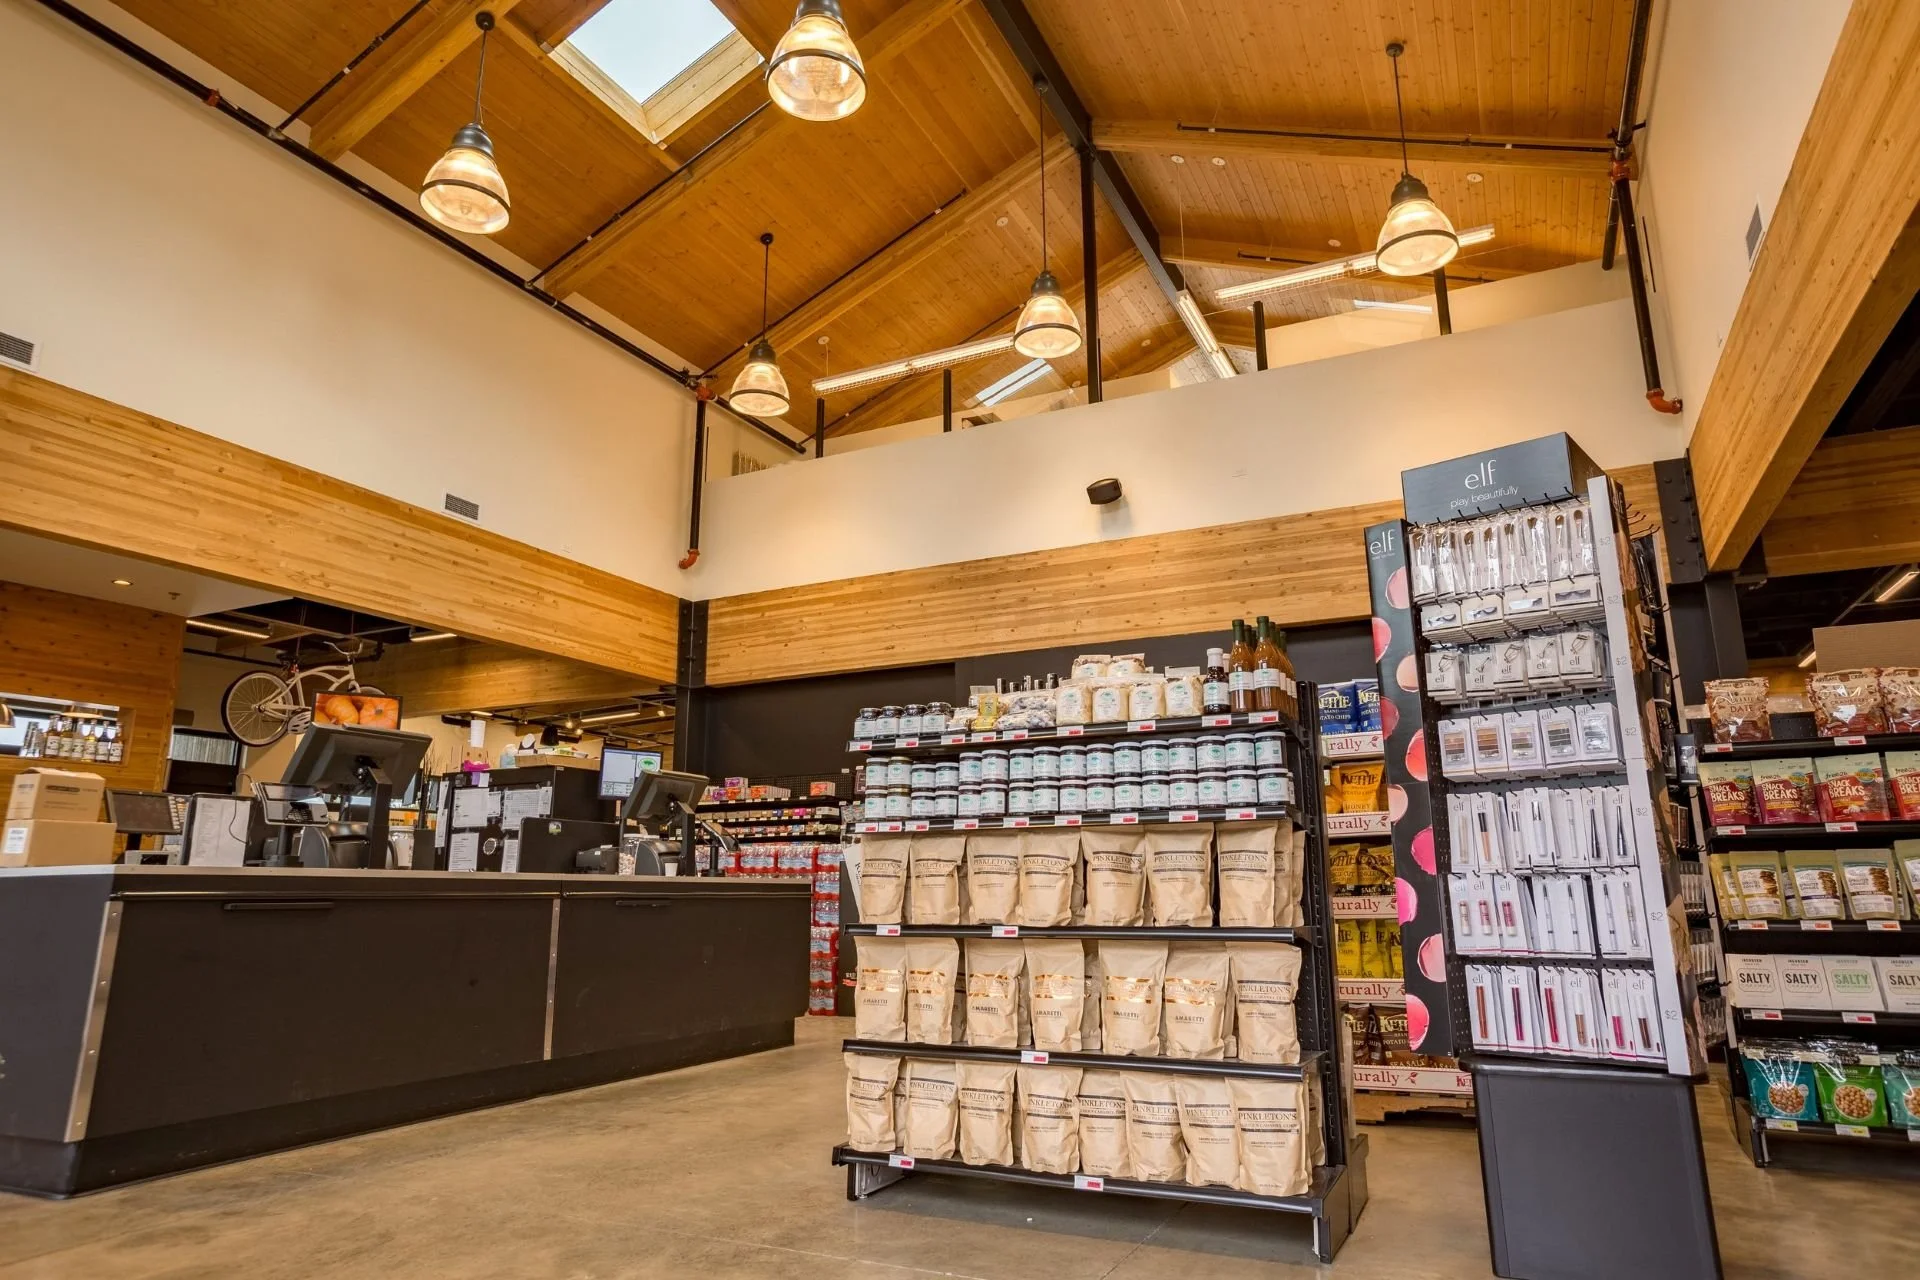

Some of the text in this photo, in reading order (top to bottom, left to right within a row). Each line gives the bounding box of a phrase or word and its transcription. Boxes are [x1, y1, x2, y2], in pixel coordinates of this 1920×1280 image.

[1450, 485, 1519, 510] play beautifully
[1570, 656, 1581, 667] elf
[1615, 656, 1627, 666] $2
[1435, 675, 1445, 684] elf
[1474, 675, 1484, 685] elf
[1730, 704, 1754, 713] DATE
[1624, 726, 1637, 737] $2
[1708, 784, 1731, 793] SNACK
[1761, 783, 1785, 792] SNACK
[1827, 779, 1852, 789] SNACK
[1899, 783, 1920, 794] BRE
[1710, 791, 1746, 803] BREAKS
[1763, 788, 1798, 801] BREAKS
[1828, 785, 1866, 799] BREAKS
[1453, 803, 1464, 812] elf
[1476, 801, 1487, 811] elf
[1635, 807, 1648, 818] $2
[1093, 854, 1143, 865] PINKLETON'S
[1154, 854, 1205, 863] PINKLETON'S
[1473, 880, 1485, 892] elf
[1500, 881, 1511, 892] elf
[1651, 911, 1664, 922] $2
[1472, 973, 1484, 984] elf
[1507, 975, 1520, 985] elf
[1544, 975, 1555, 986] elf
[1570, 977, 1583, 988] elf
[1608, 978, 1620, 989] elf
[1739, 972, 1771, 985] SALTY
[1785, 973, 1818, 985] SALTY
[1834, 973, 1869, 985] SALTY
[1632, 979, 1646, 991] elf
[972, 1005, 999, 1014] AMARETTI
[1113, 1010, 1139, 1019] AMARETTI
[1664, 1009, 1678, 1021] $2
[1406, 1058, 1426, 1067] SALT
[1079, 1099, 1126, 1109] INKLETON'
[1238, 1112, 1297, 1121] PINKLETON'S
